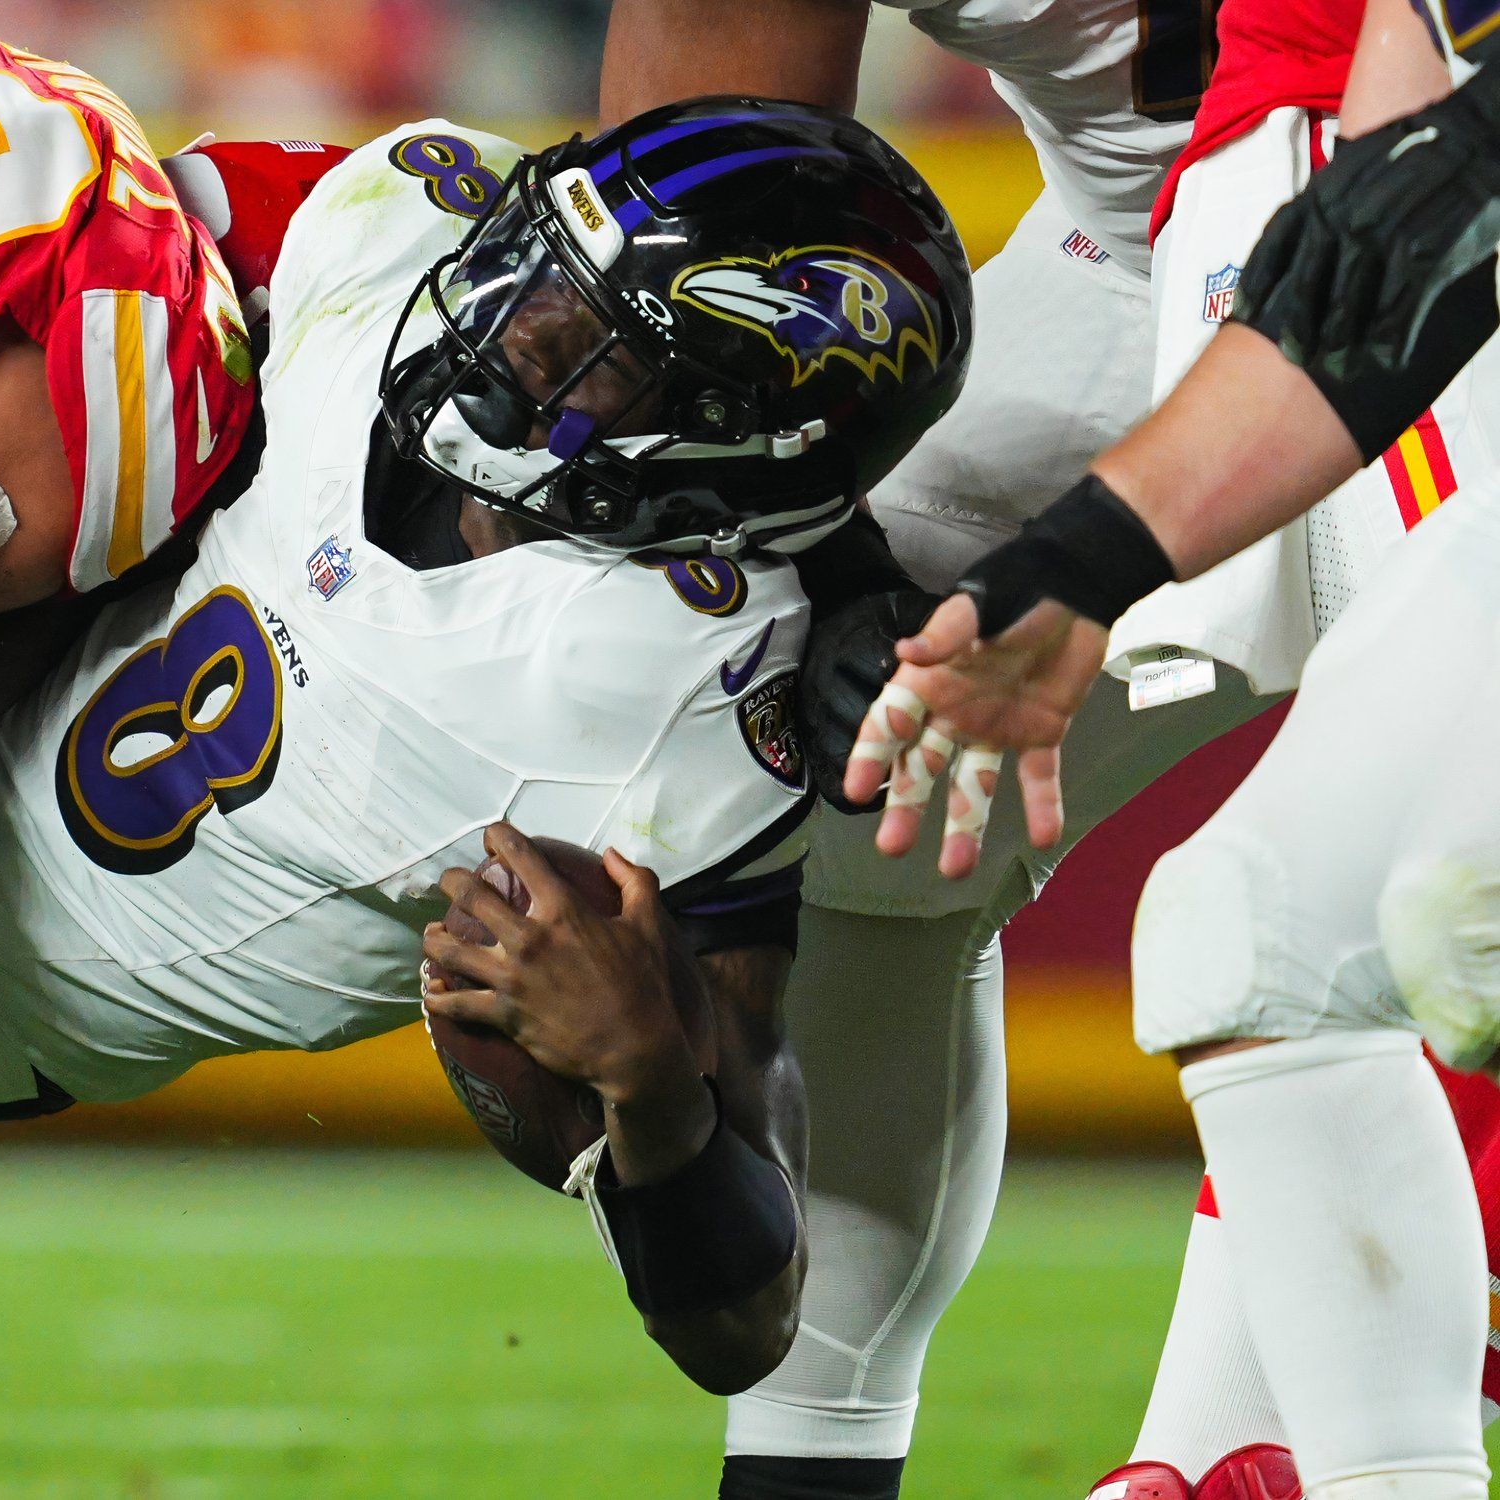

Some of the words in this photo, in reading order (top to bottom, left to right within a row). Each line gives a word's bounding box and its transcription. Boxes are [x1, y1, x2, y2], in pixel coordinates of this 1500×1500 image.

[388, 134, 506, 220] 8
[567, 179, 604, 232] RAVENS
[1066, 231, 1100, 260] NFL
[1206, 289, 1233, 321] NF
[310, 554, 336, 593] NFL
[264, 606, 310, 688] VENS
[55, 583, 283, 875] 8
